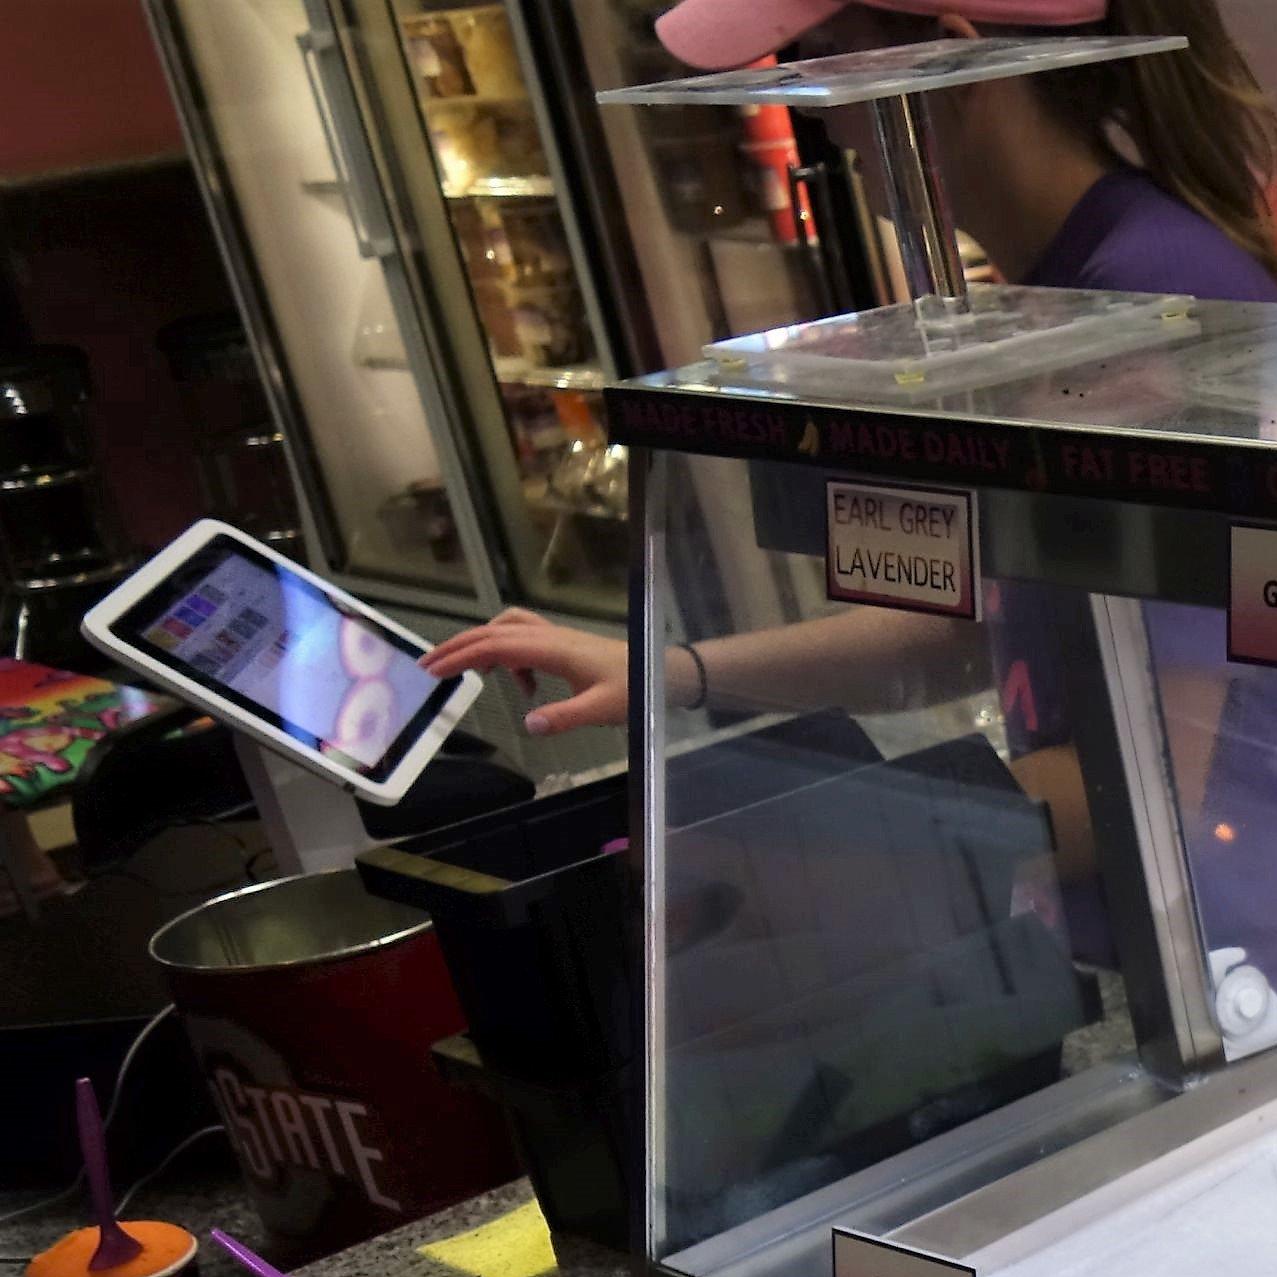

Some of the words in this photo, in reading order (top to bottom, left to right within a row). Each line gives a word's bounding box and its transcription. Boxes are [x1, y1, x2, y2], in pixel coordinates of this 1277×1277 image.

[622, 404, 697, 434] MADE
[704, 410, 787, 447] FRESH
[826, 421, 918, 460] MADE
[922, 431, 1011, 473] DAILY
[1059, 444, 1112, 481] FAT
[1129, 454, 1211, 493] FREE
[834, 493, 892, 532] EARL
[901, 502, 954, 539] GREY
[836, 545, 956, 593] LAVENDER
[208, 1068, 405, 1215] STATE
